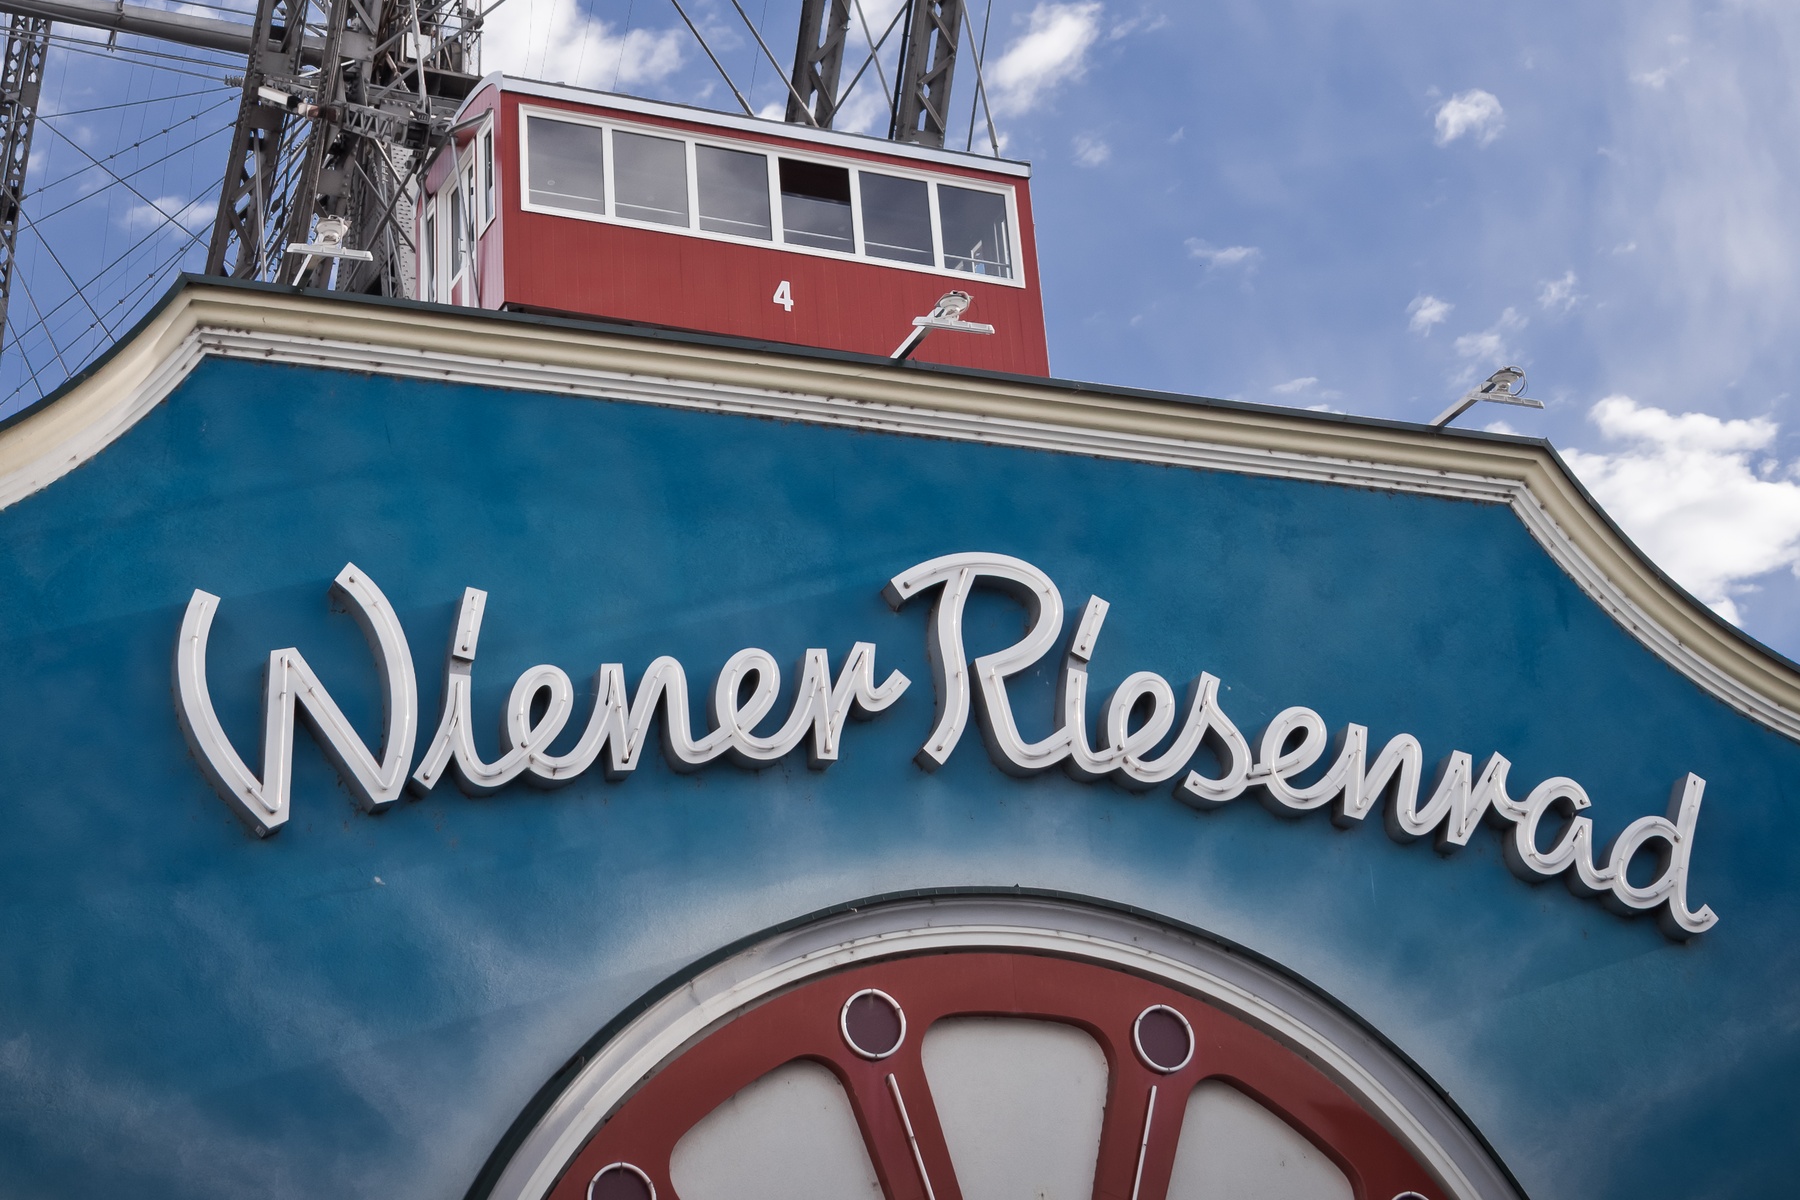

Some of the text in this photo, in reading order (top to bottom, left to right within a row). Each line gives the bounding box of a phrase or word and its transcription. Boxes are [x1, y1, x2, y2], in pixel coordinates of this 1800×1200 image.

[773, 280, 794, 312] 4
[172, 551, 1719, 942] Wiener Riesenrad
